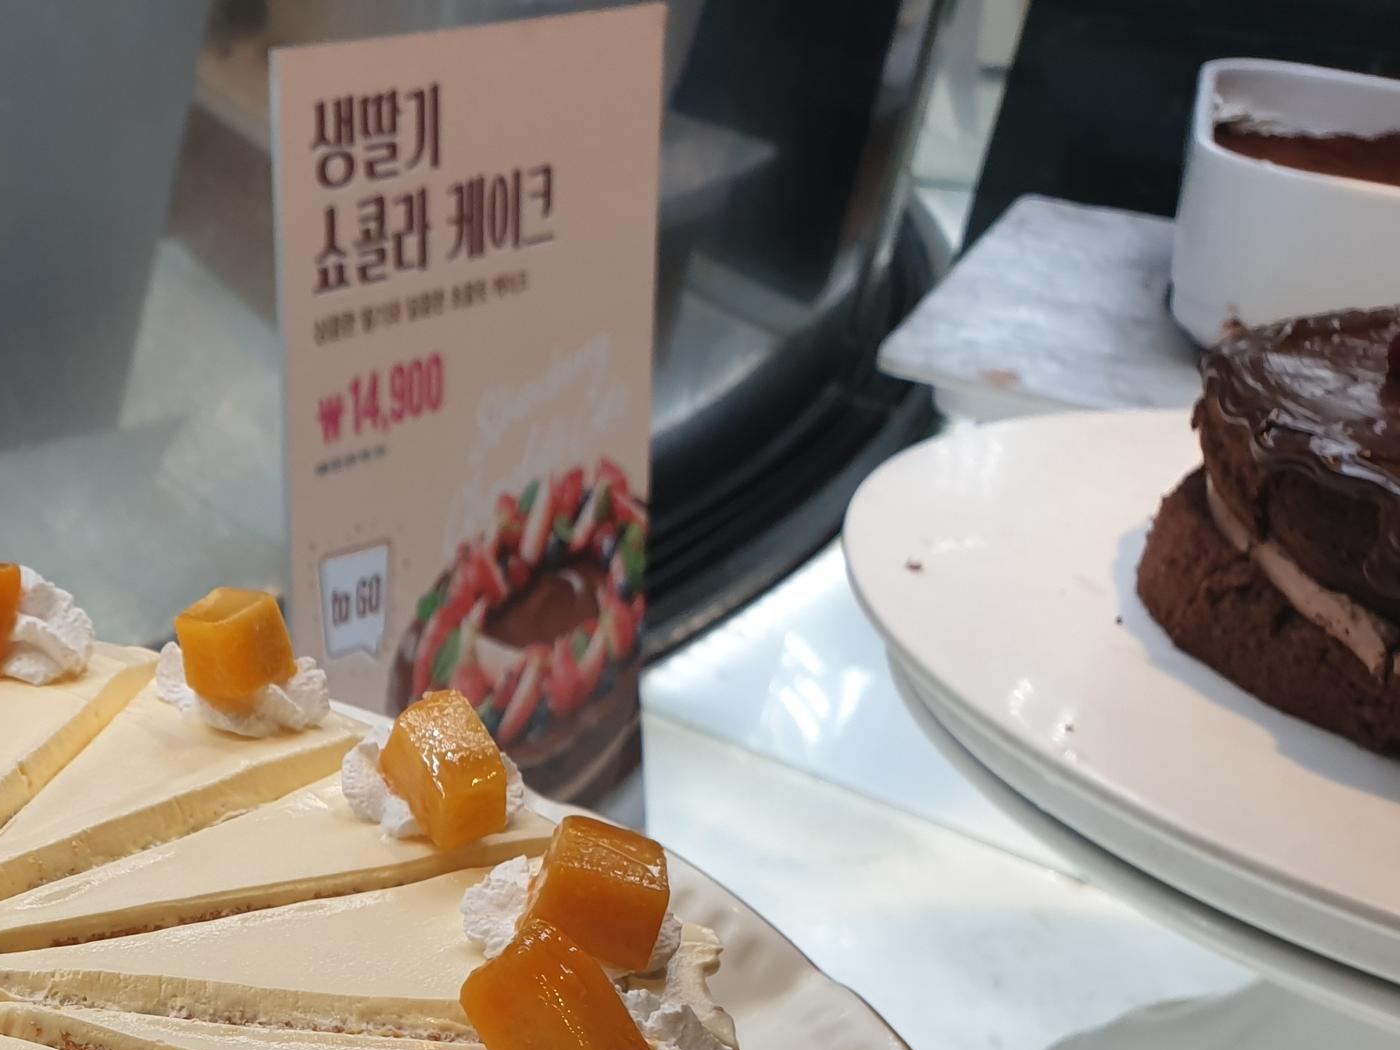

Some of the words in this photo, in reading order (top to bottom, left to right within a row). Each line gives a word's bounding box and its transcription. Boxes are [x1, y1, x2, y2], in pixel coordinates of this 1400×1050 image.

[311, 82, 440, 189] 생딸기
[313, 186, 431, 294] 쇼콜라
[447, 163, 555, 260] 케이크
[318, 352, 445, 446] ₩14,900
[331, 590, 351, 628] to
